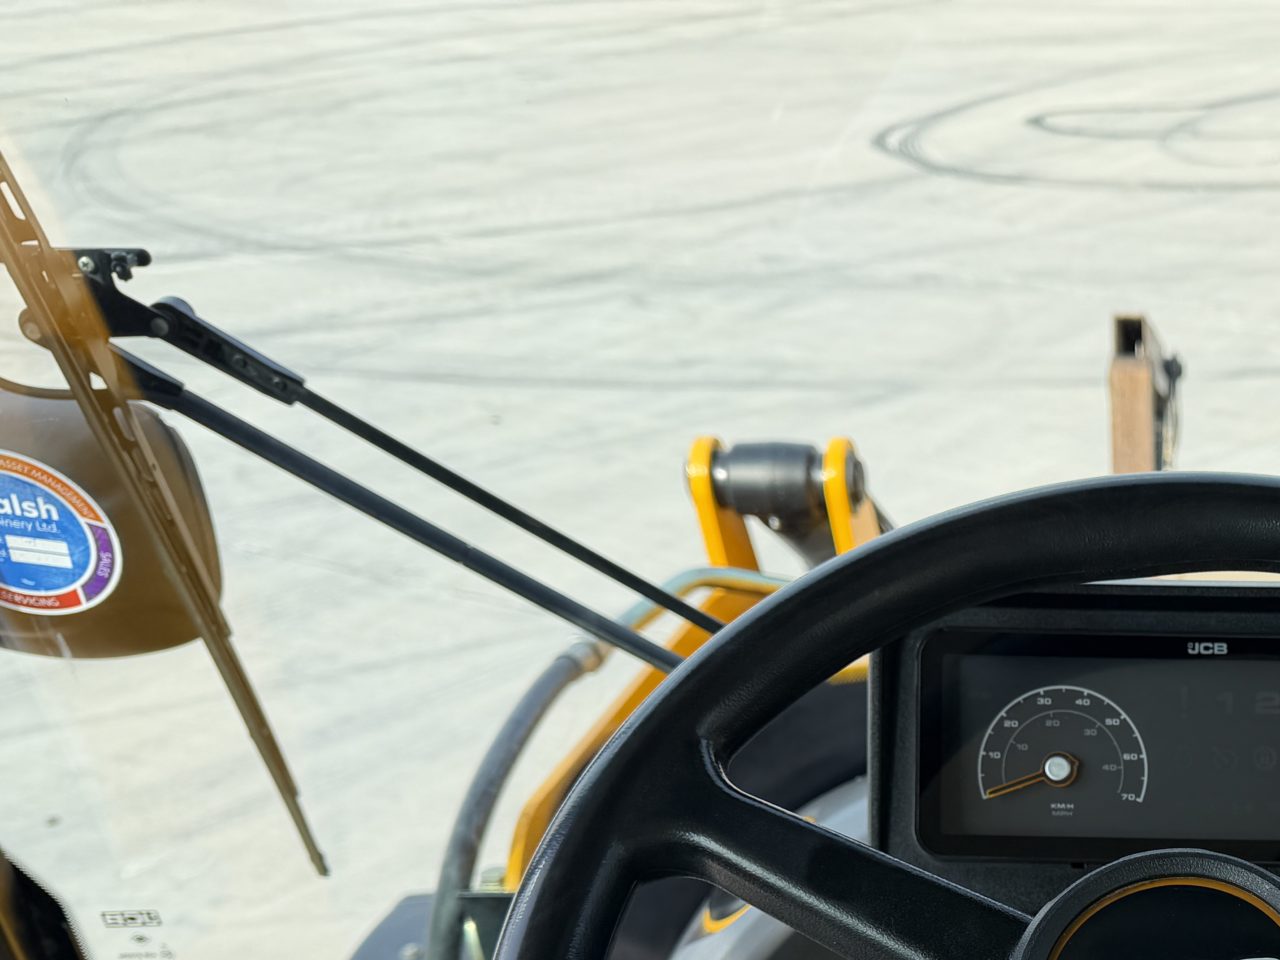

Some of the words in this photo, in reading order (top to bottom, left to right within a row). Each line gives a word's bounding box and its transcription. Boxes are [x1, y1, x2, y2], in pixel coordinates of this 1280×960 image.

[1187, 642, 1228, 655] JCB
[1037, 697, 1052, 705] 30
[1075, 698, 1090, 706] 40
[1003, 719, 1019, 728] 20
[1045, 719, 1060, 727] 20
[1105, 718, 1120, 726] 50
[1083, 728, 1098, 736] 30
[1016, 743, 1029, 751] 10
[988, 751, 1001, 760] 10
[1123, 753, 1138, 761] 60
[1121, 793, 1136, 801] 70
